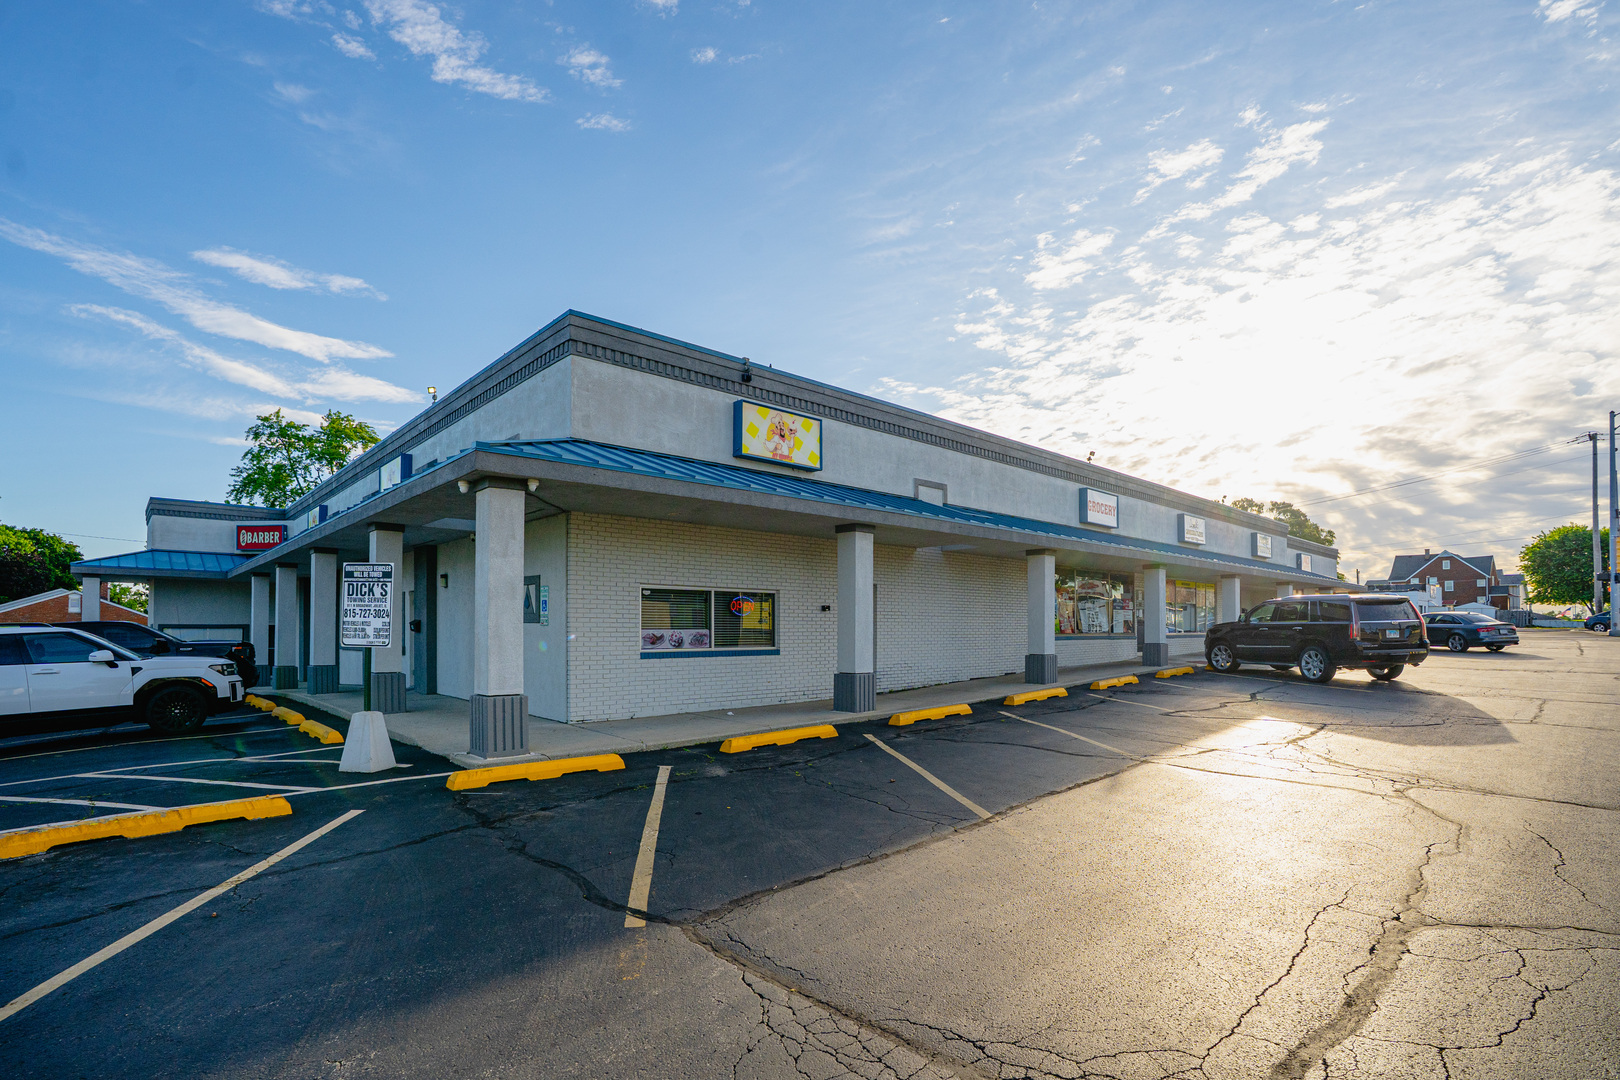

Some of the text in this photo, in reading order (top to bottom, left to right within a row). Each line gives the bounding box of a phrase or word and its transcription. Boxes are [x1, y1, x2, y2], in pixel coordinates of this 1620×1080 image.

[1088, 499, 1116, 517] GROCERY
[246, 532, 279, 543] BARBER
[347, 583, 388, 596] DICK'S
[730, 600, 755, 611] OPEN
